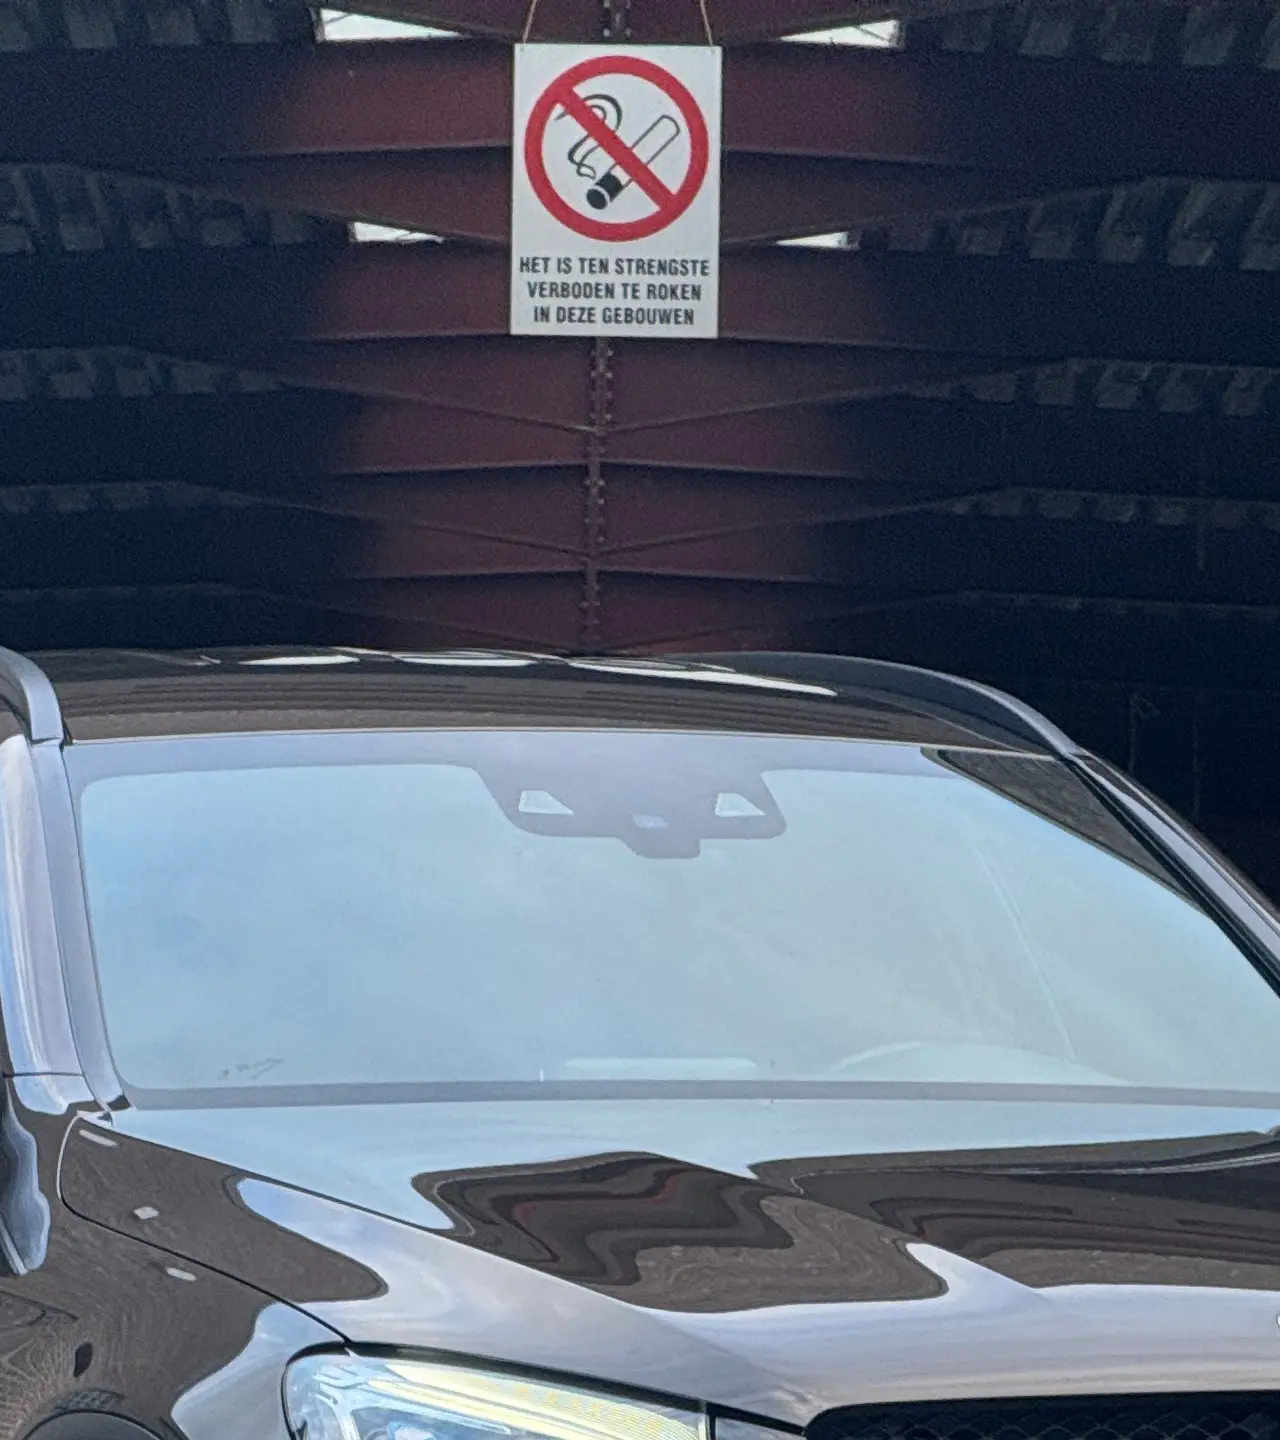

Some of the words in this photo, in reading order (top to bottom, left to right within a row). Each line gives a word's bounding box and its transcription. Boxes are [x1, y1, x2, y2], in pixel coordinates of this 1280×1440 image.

[519, 257, 551, 273] HET
[557, 258, 572, 273] IS
[579, 258, 609, 274] TEN
[615, 258, 709, 276] STRENGSTE
[527, 282, 615, 299] VERBODEN
[622, 283, 641, 299] TE
[647, 284, 701, 301] ROKEN
[534, 307, 550, 323] IN
[557, 307, 596, 324] DEZE
[602, 308, 694, 324] GEBOUWEN
